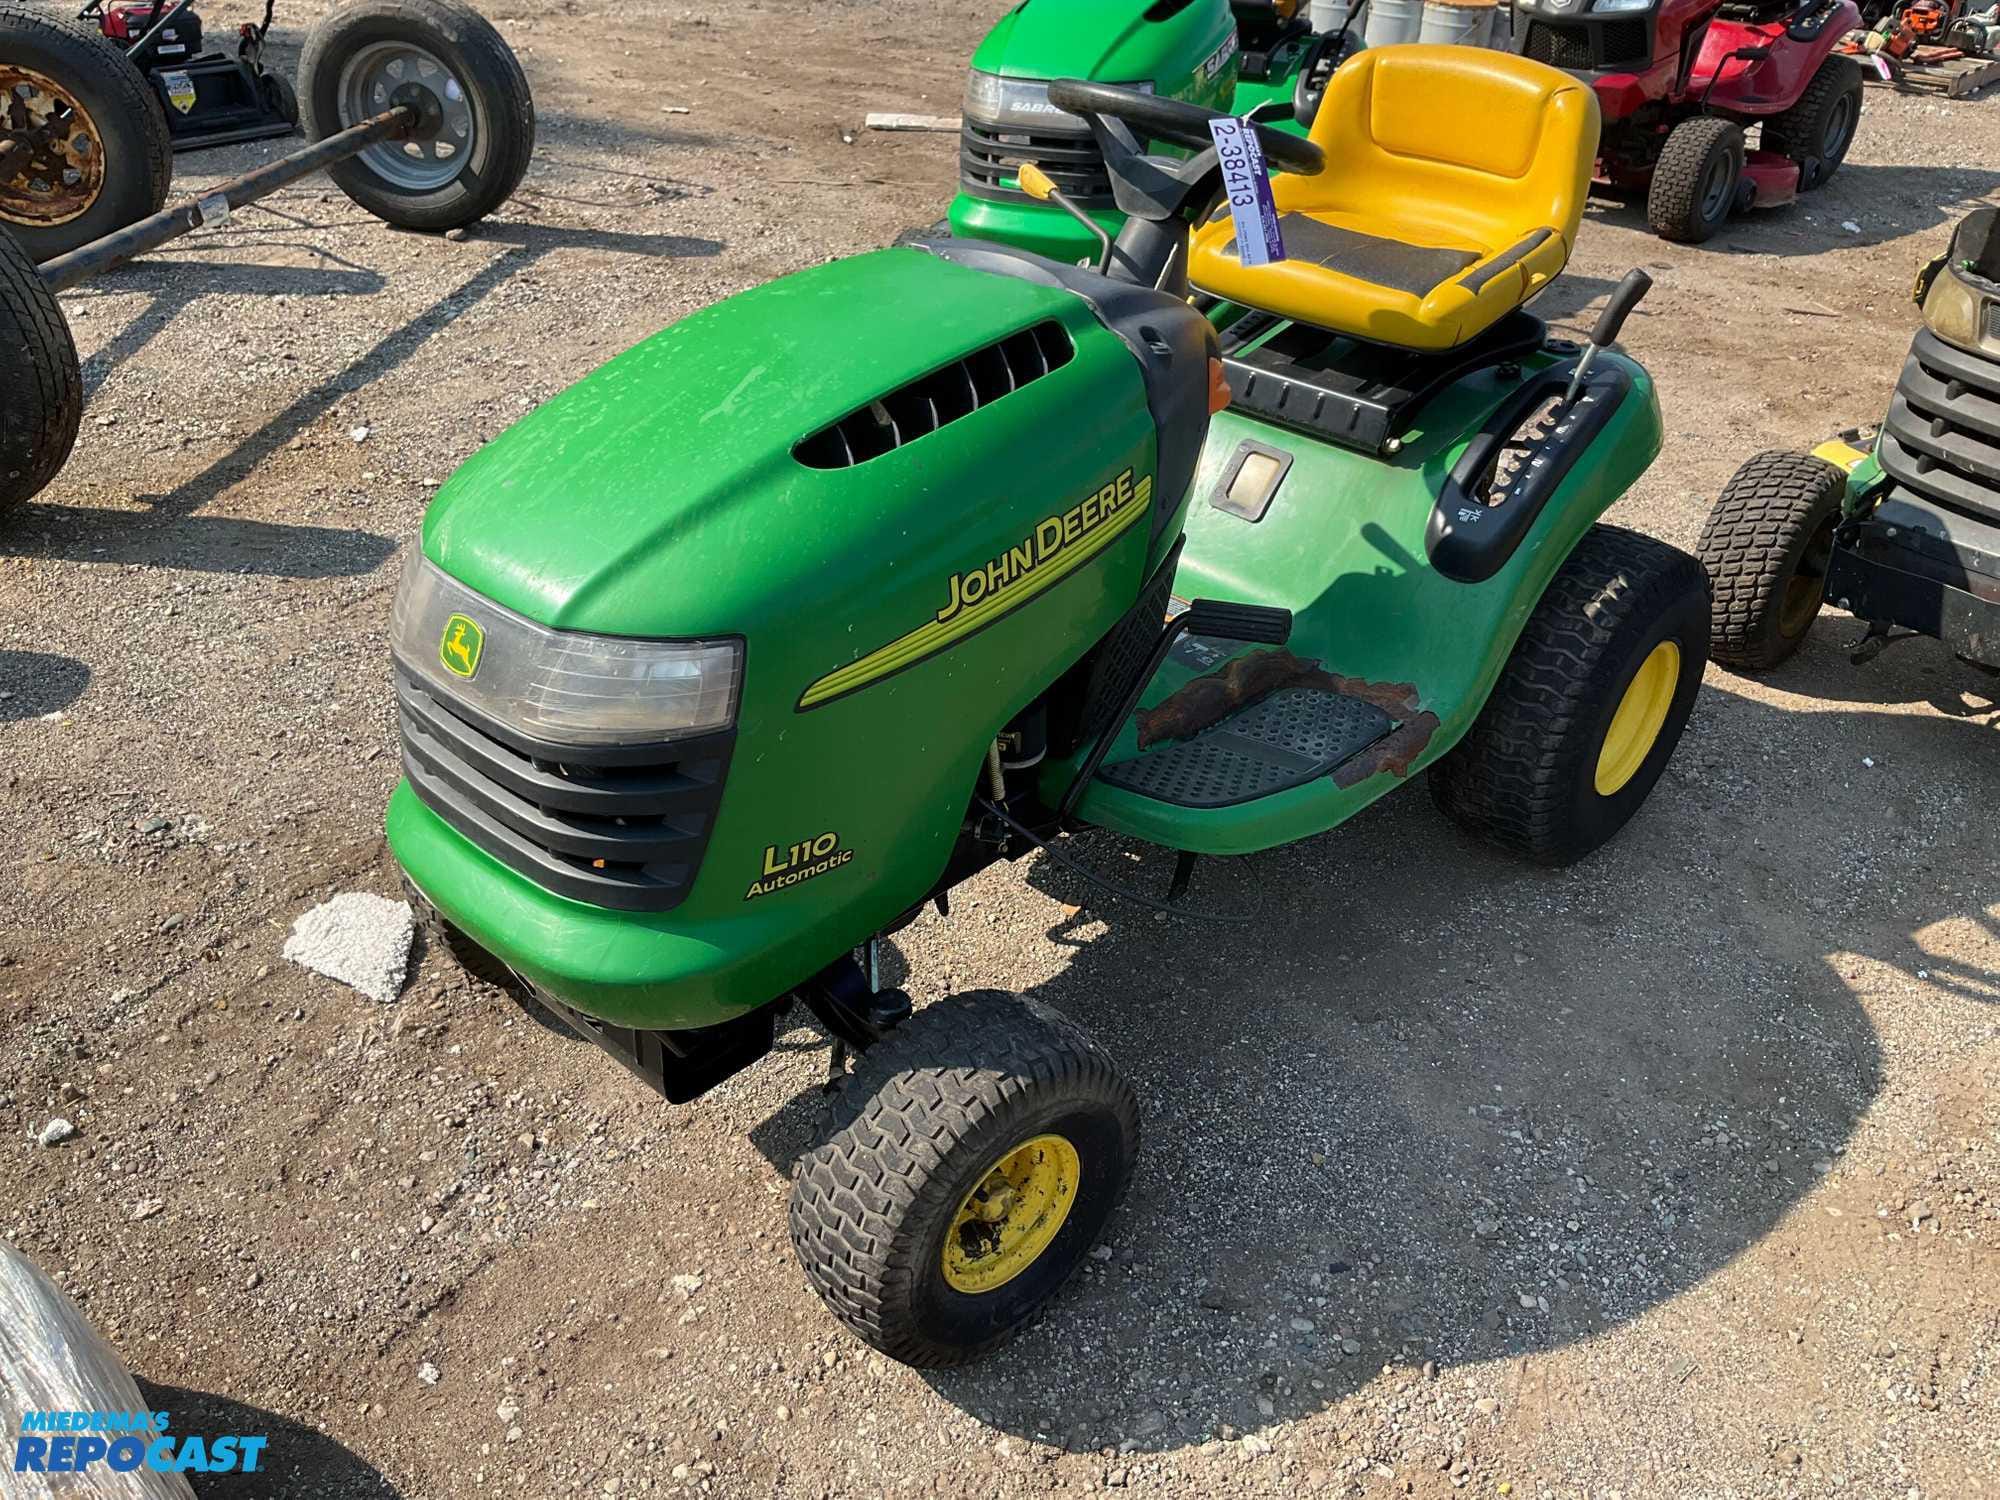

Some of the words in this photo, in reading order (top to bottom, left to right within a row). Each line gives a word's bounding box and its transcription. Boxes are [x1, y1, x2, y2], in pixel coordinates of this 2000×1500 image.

[1214, 124, 1255, 207] 2-38413
[937, 538, 1035, 622] JOHN
[1035, 467, 1135, 562] DEERE
[746, 850, 853, 899] Automatic
[763, 831, 838, 876] L110
